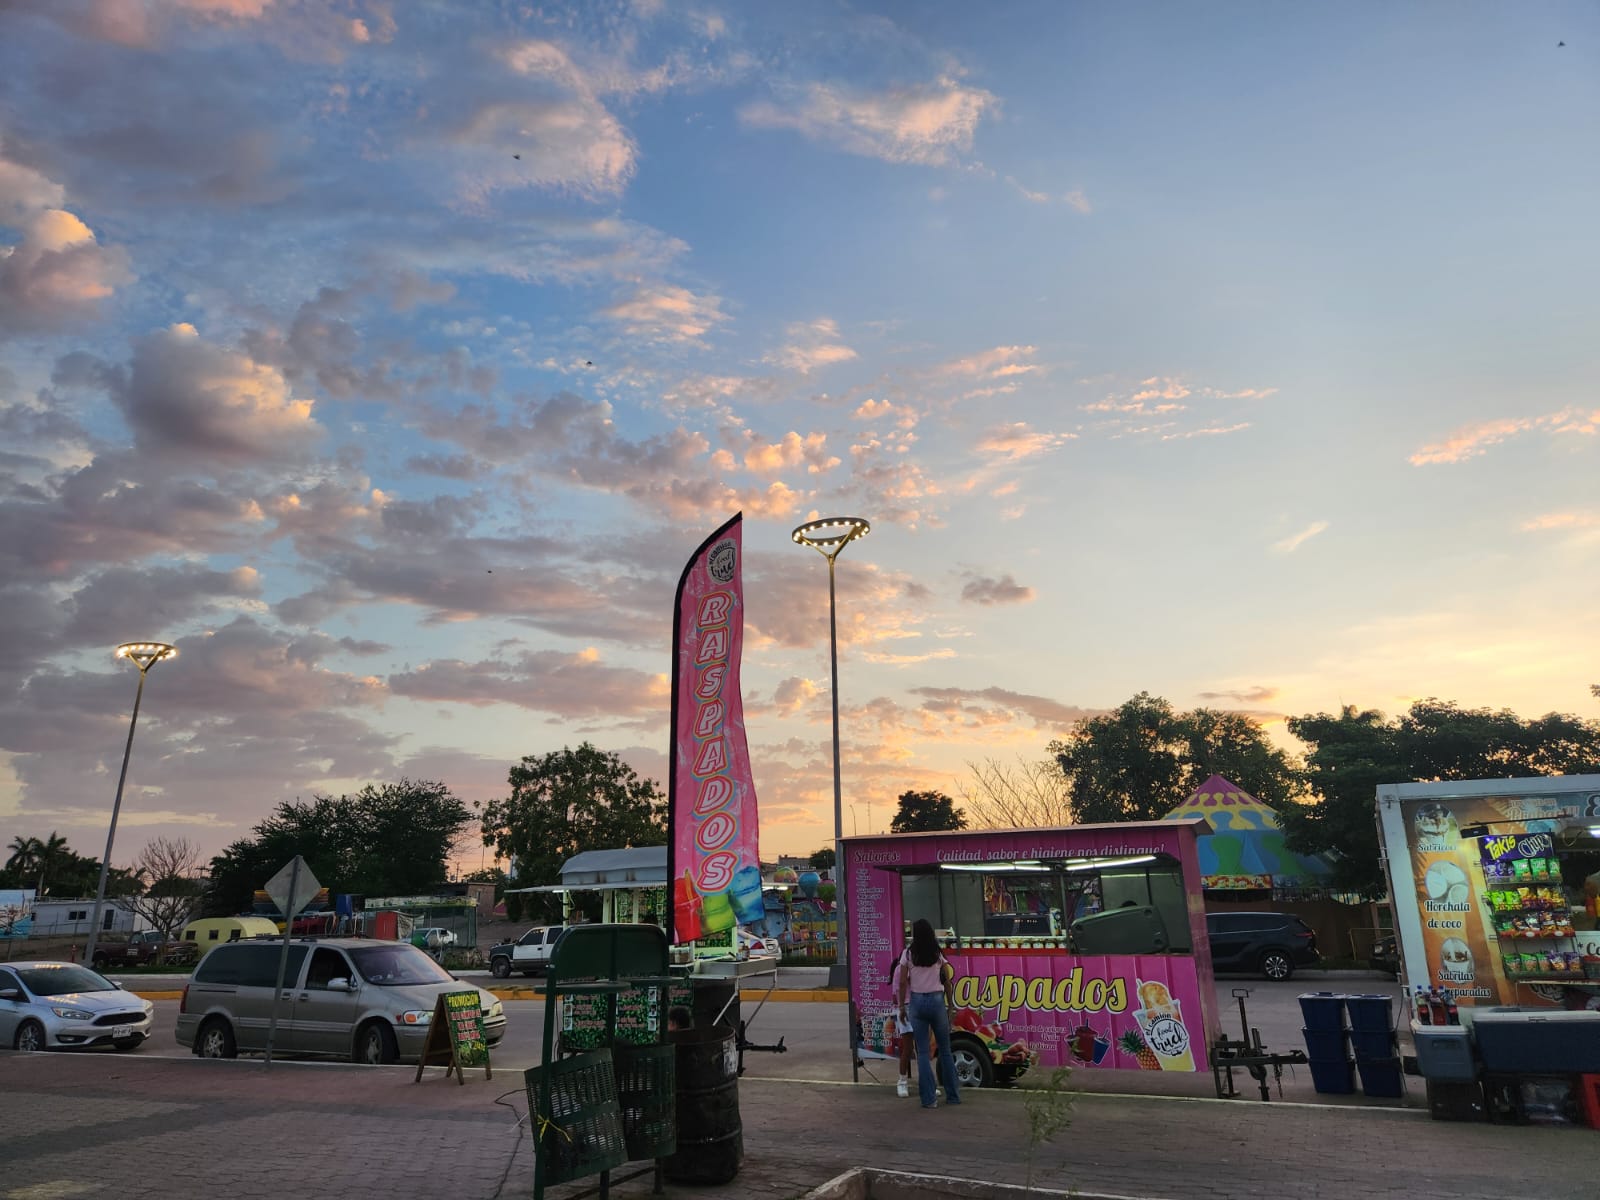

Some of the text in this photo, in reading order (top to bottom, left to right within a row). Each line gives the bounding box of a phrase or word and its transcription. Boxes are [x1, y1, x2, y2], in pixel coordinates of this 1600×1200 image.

[694, 593, 738, 892] RASPADOS
[986, 849, 1018, 861] sabor
[1022, 851, 1028, 859] e
[1030, 847, 1075, 858] higiene
[1485, 835, 1516, 860] Takis
[1424, 899, 1470, 912] Horchata
[1428, 918, 1462, 929] de coco
[1438, 970, 1474, 981] Sabritas
[1150, 1022, 1189, 1052] truck
